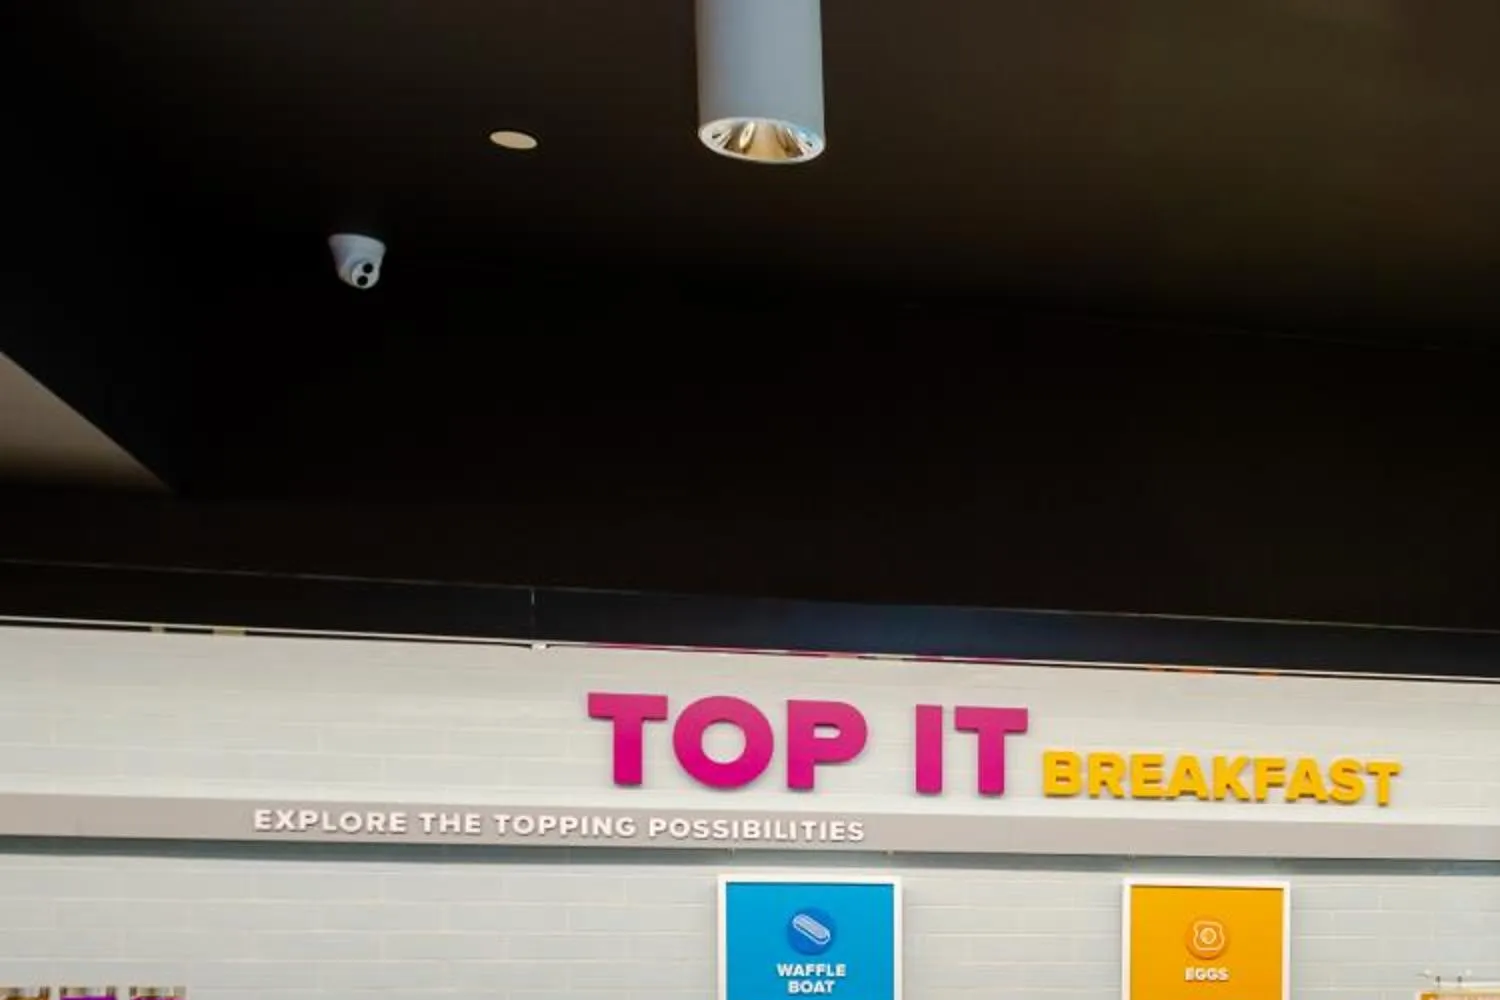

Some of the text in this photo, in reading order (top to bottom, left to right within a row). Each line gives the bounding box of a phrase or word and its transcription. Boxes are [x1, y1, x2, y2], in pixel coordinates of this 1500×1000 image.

[588, 692, 1029, 797] TOP IT
[1042, 750, 1403, 807] BREAKFAST
[253, 808, 866, 843] EXPLORE THE TOPPING POSSIBILITIES
[776, 963, 848, 978] WAFFLE
[1184, 967, 1230, 982] EGGS
[787, 980, 836, 994] BOAT
